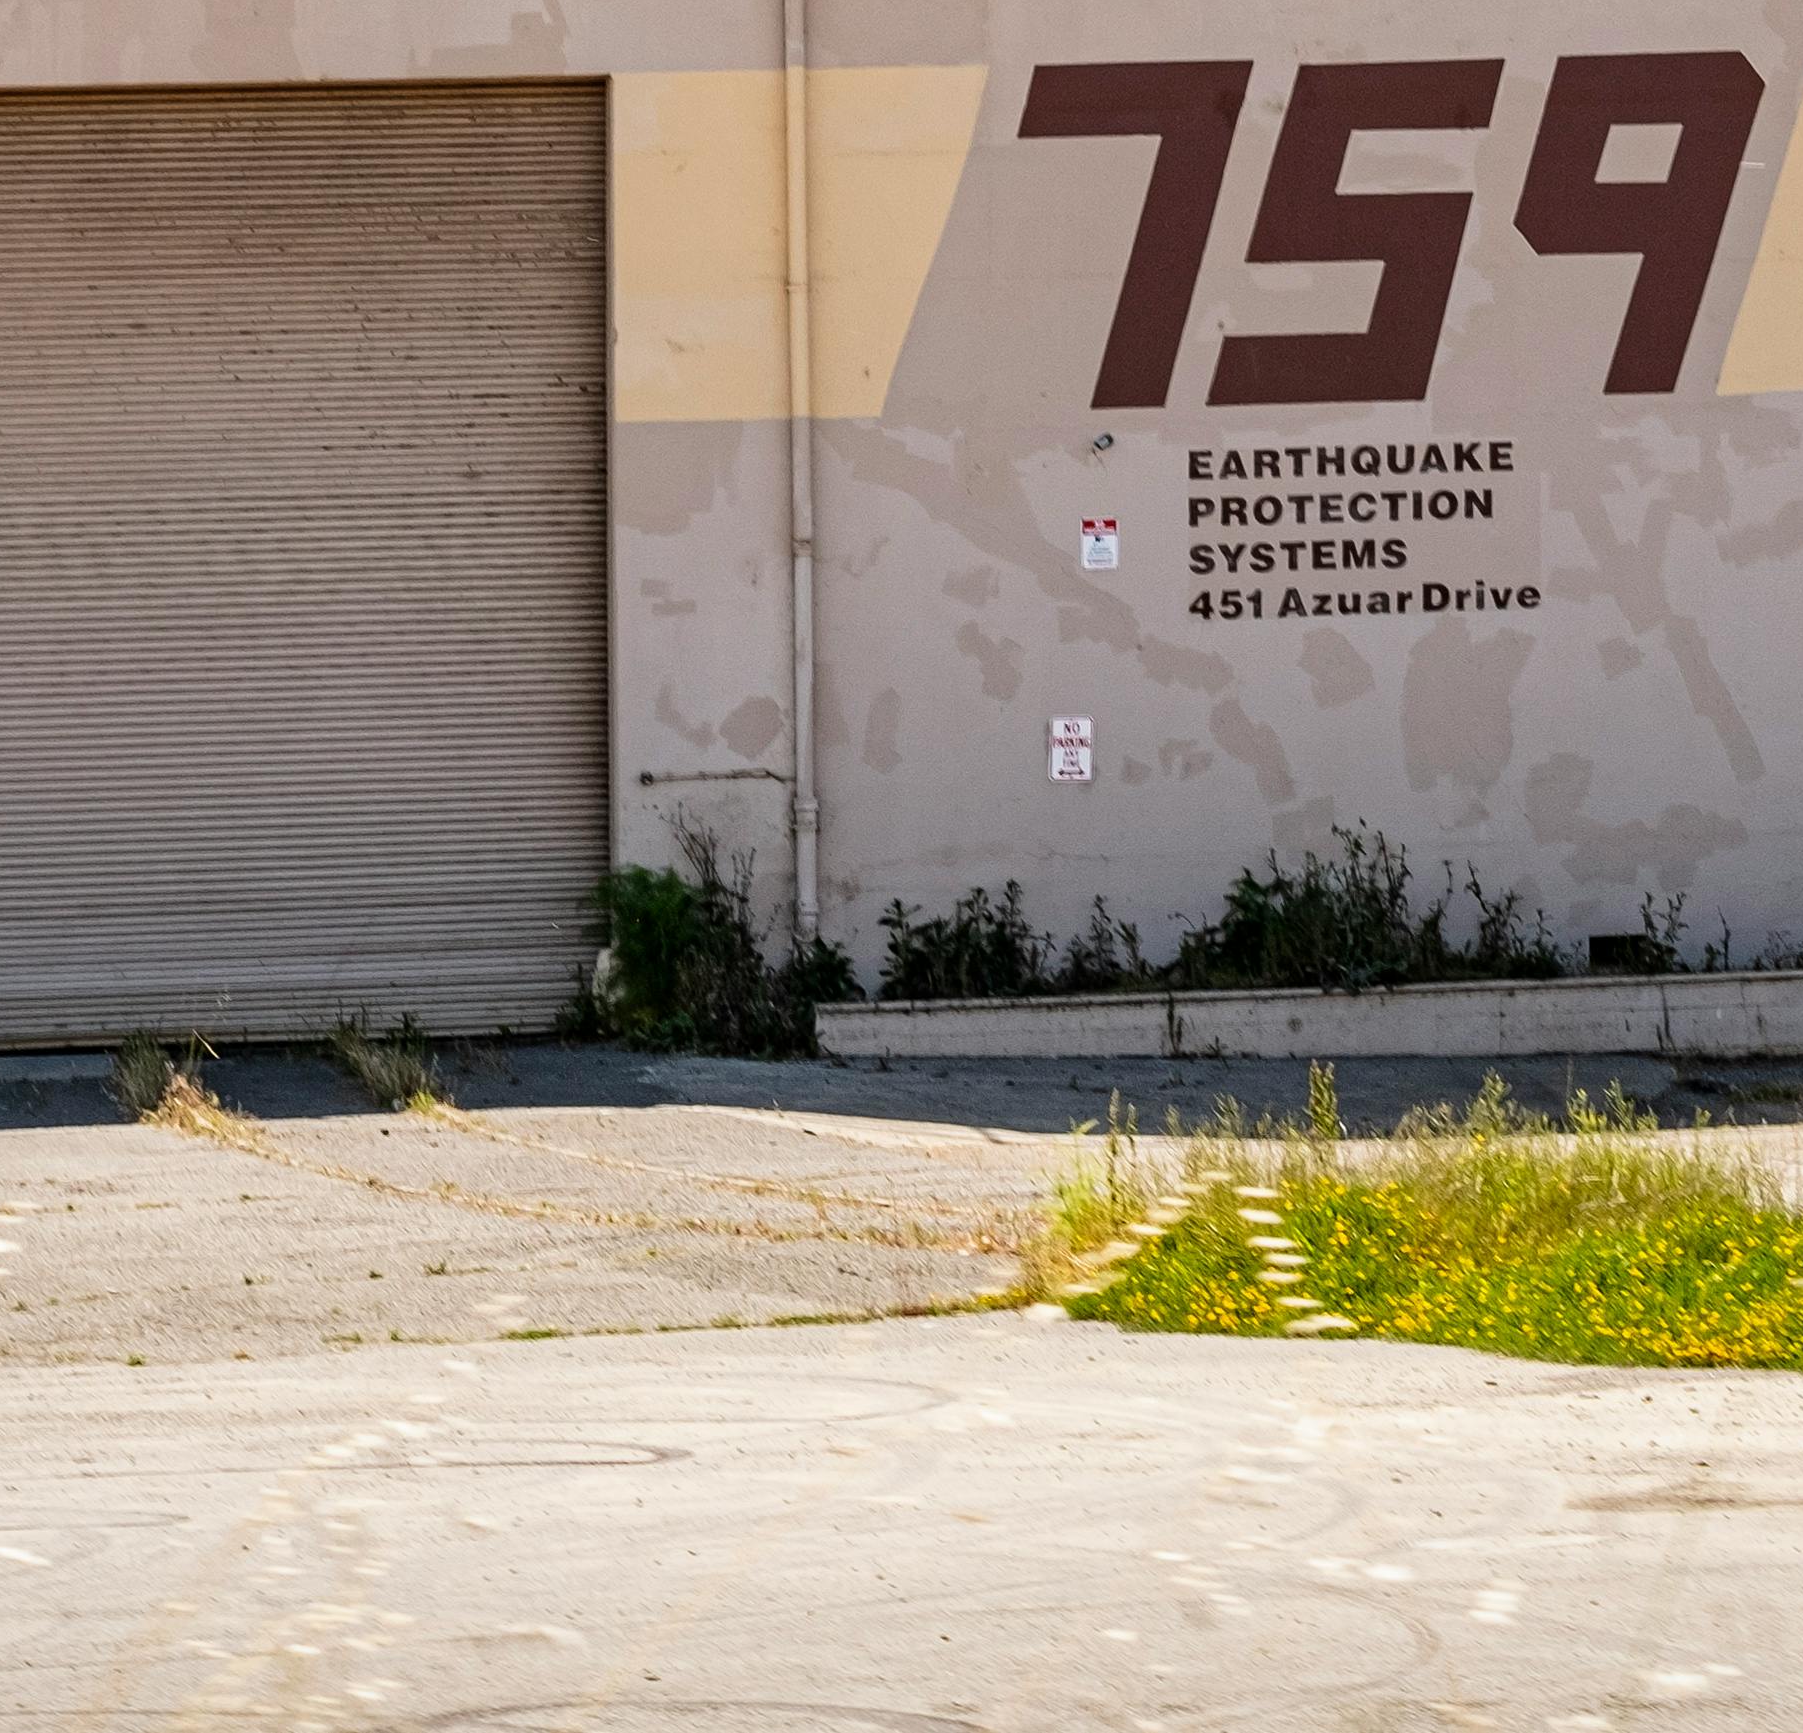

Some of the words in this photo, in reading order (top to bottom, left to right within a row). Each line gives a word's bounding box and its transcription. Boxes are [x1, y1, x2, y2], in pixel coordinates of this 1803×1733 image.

[1018, 51, 1765, 409] 759
[1188, 441, 1514, 480] EARTHQUAKE
[1188, 488, 1494, 527] PROTECTION
[1188, 539, 1409, 575] SYSTEMS
[1188, 589, 1263, 619] 451
[1277, 587, 1412, 619] Azuar
[1421, 580, 1542, 612] Drive
[1052, 737, 1090, 748] PARKING
[1064, 722, 1080, 734] NO
